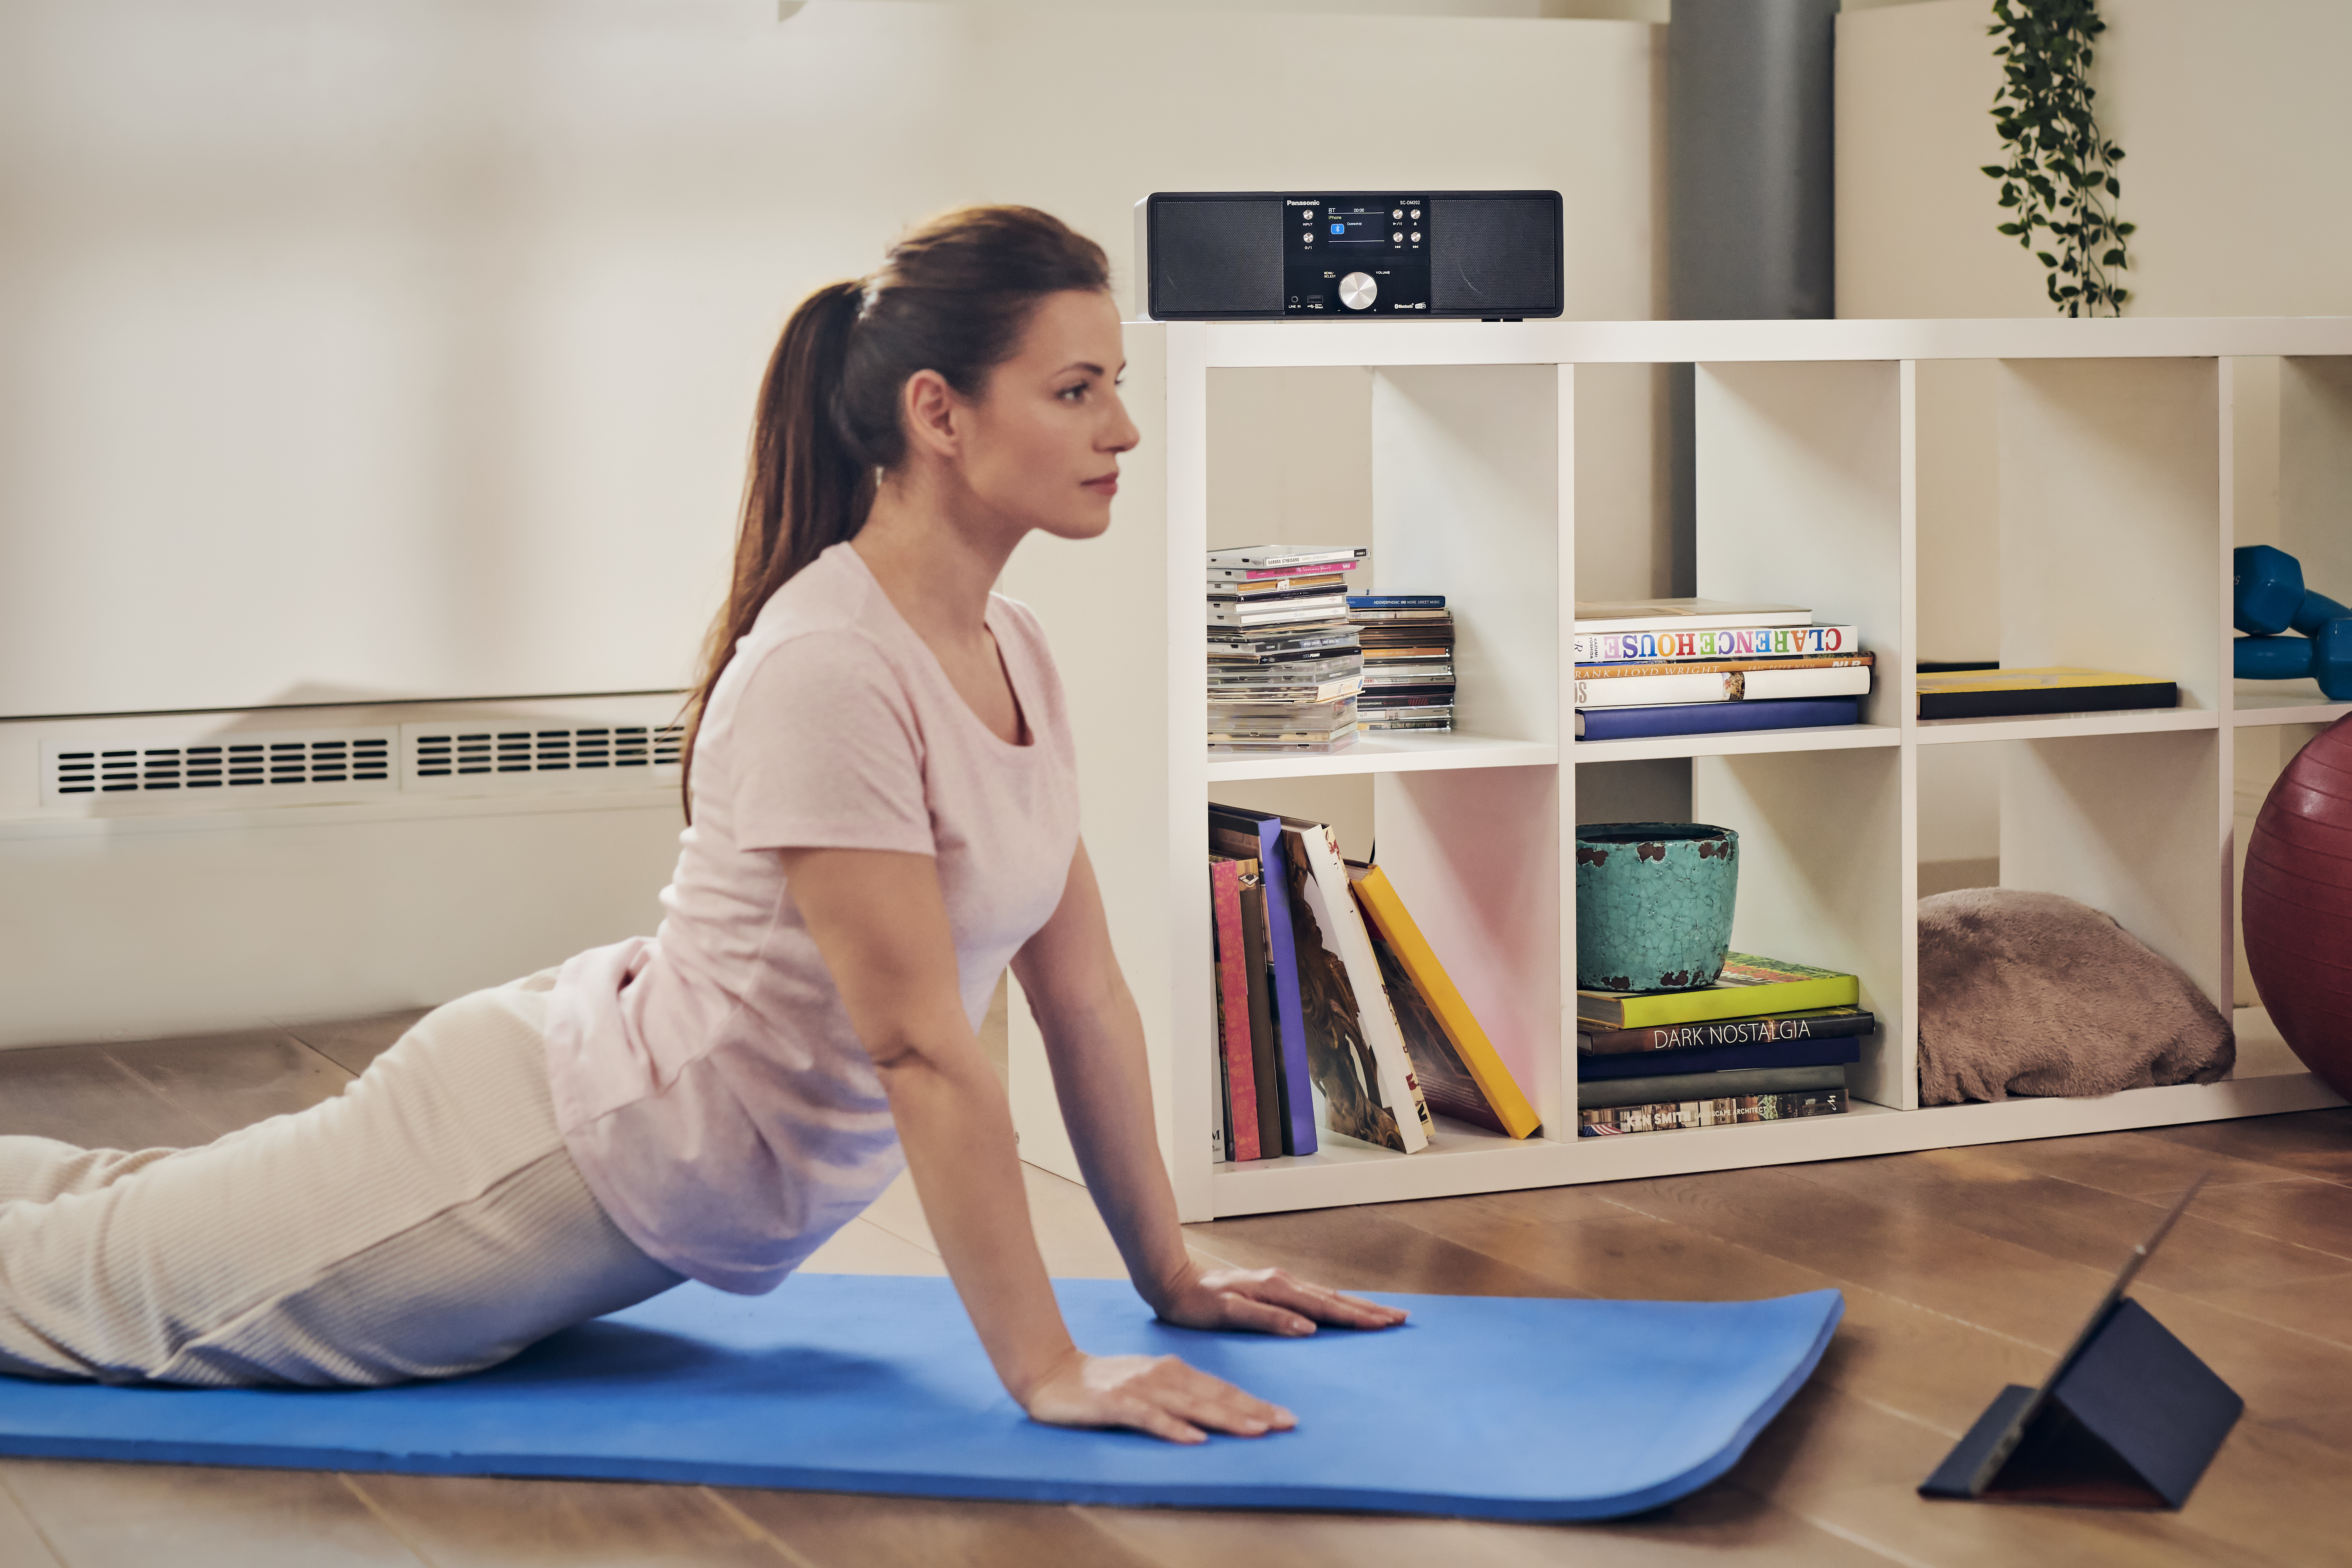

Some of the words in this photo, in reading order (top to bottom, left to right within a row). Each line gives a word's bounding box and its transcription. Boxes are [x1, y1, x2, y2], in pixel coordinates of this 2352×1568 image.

[1604, 633, 1696, 658] HOUSE
[1700, 628, 1842, 655] CLARENCE
[1617, 668, 1659, 677] LLOYD
[1665, 666, 1720, 675] WRIGHT
[1654, 1027, 1704, 1049] DARK
[1710, 1020, 1811, 1045] NOSTALGIA
[1626, 1114, 1652, 1127] KEN
[1654, 1111, 1692, 1125] SMITH
[1694, 1109, 1732, 1119] LANDSCAPE
[1732, 1106, 1768, 1115] ARCHITECT
